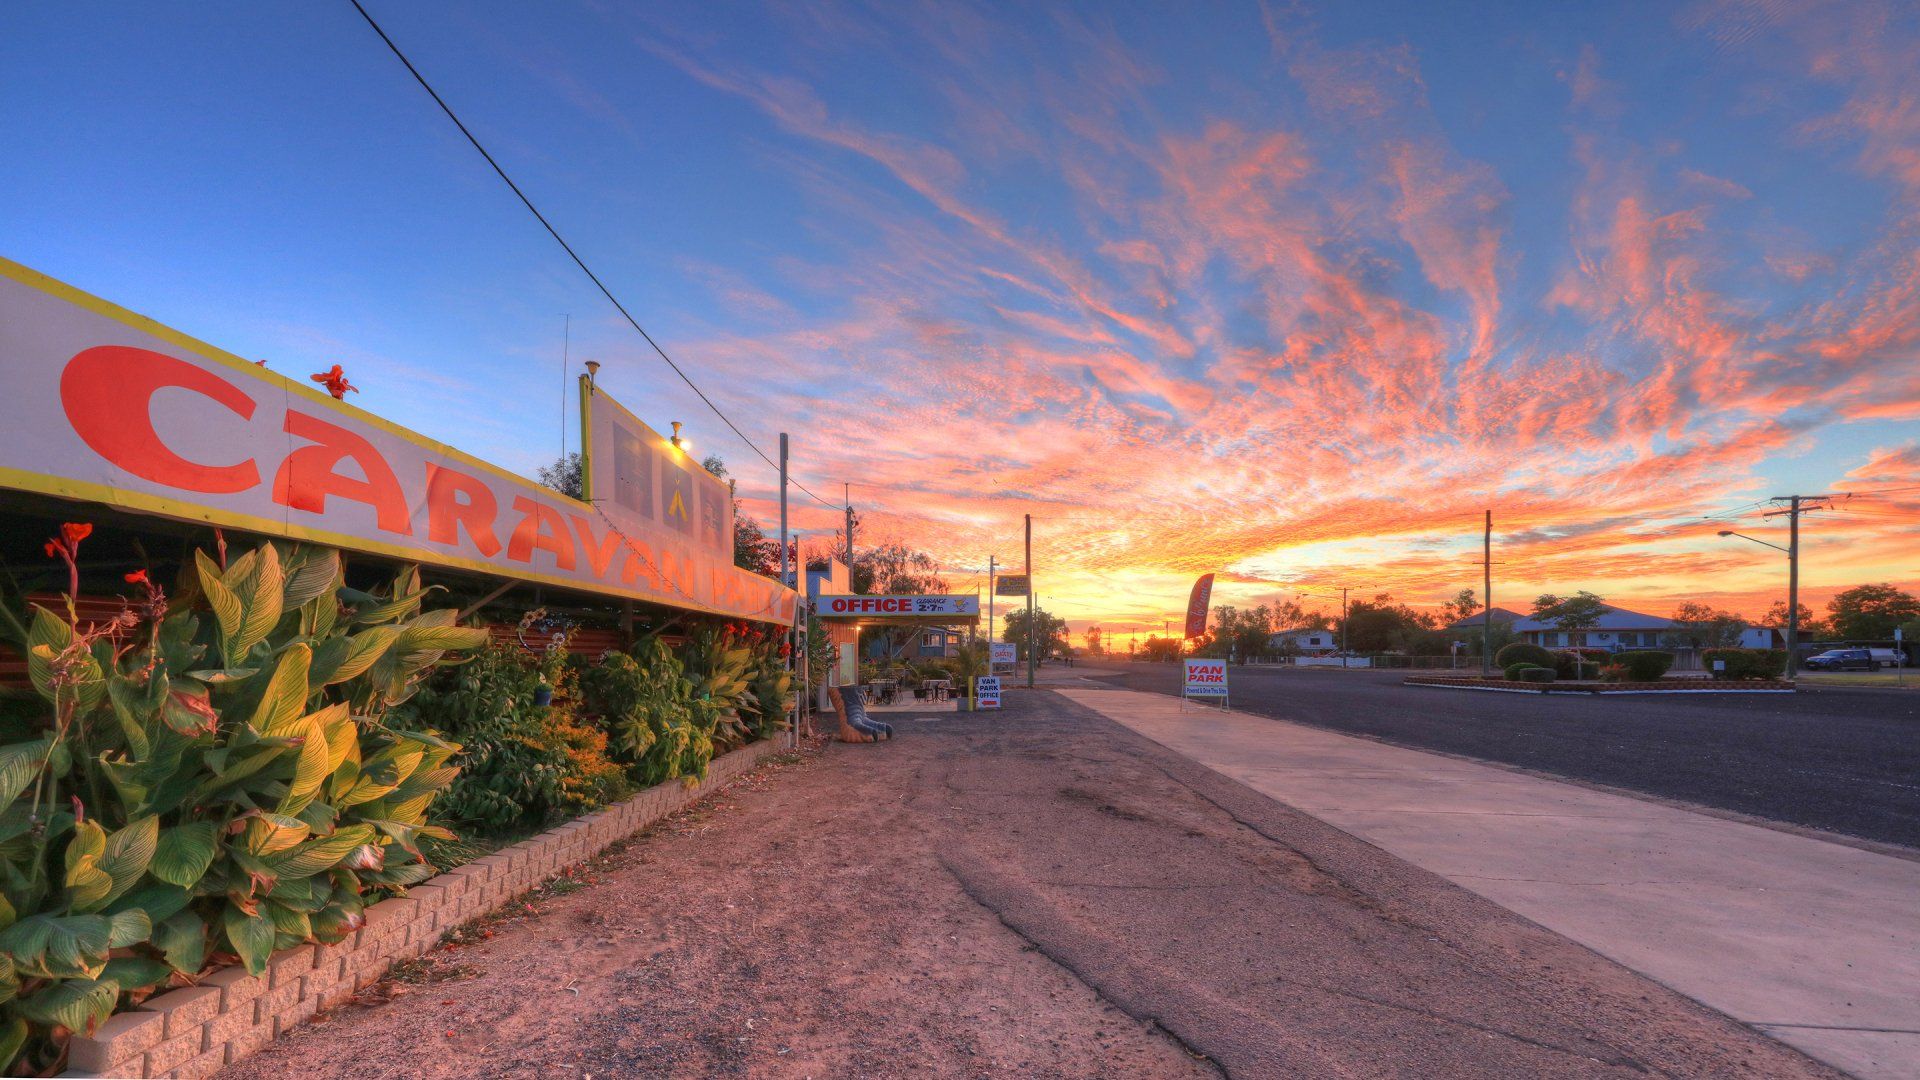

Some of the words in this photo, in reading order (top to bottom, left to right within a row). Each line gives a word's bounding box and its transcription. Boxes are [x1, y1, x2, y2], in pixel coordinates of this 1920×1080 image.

[60, 345, 694, 599] CARAVAN
[831, 598, 913, 613] OFFICE
[1188, 665, 1223, 674] VAN
[1188, 674, 1224, 682] PARK
